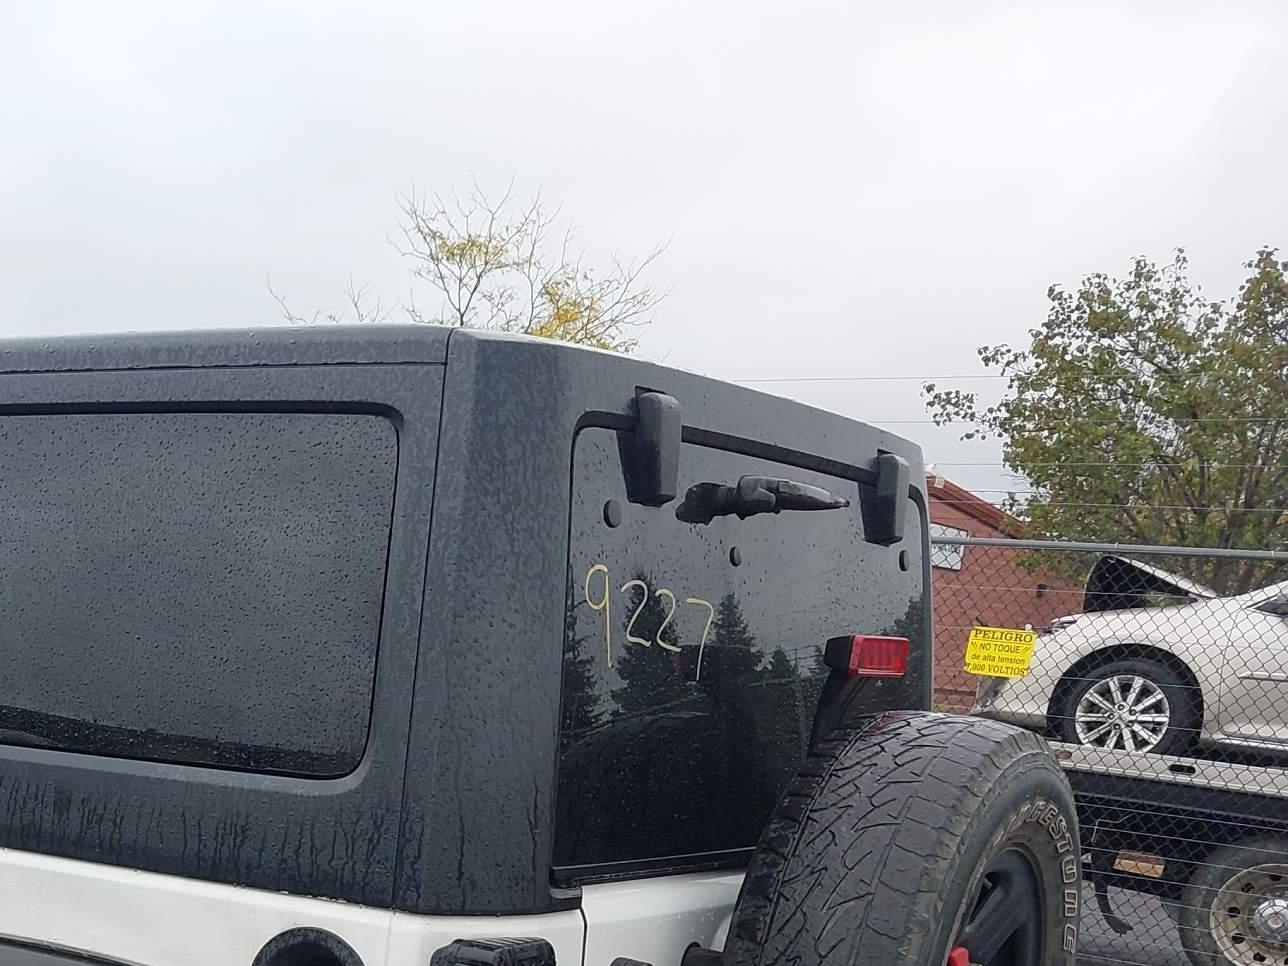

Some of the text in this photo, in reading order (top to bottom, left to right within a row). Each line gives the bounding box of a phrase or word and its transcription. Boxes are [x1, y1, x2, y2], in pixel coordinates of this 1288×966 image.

[585, 563, 713, 682] 9227
[973, 629, 1033, 643] PELIGRO
[979, 642, 1022, 654] NO TOQUE
[982, 653, 996, 662] alta
